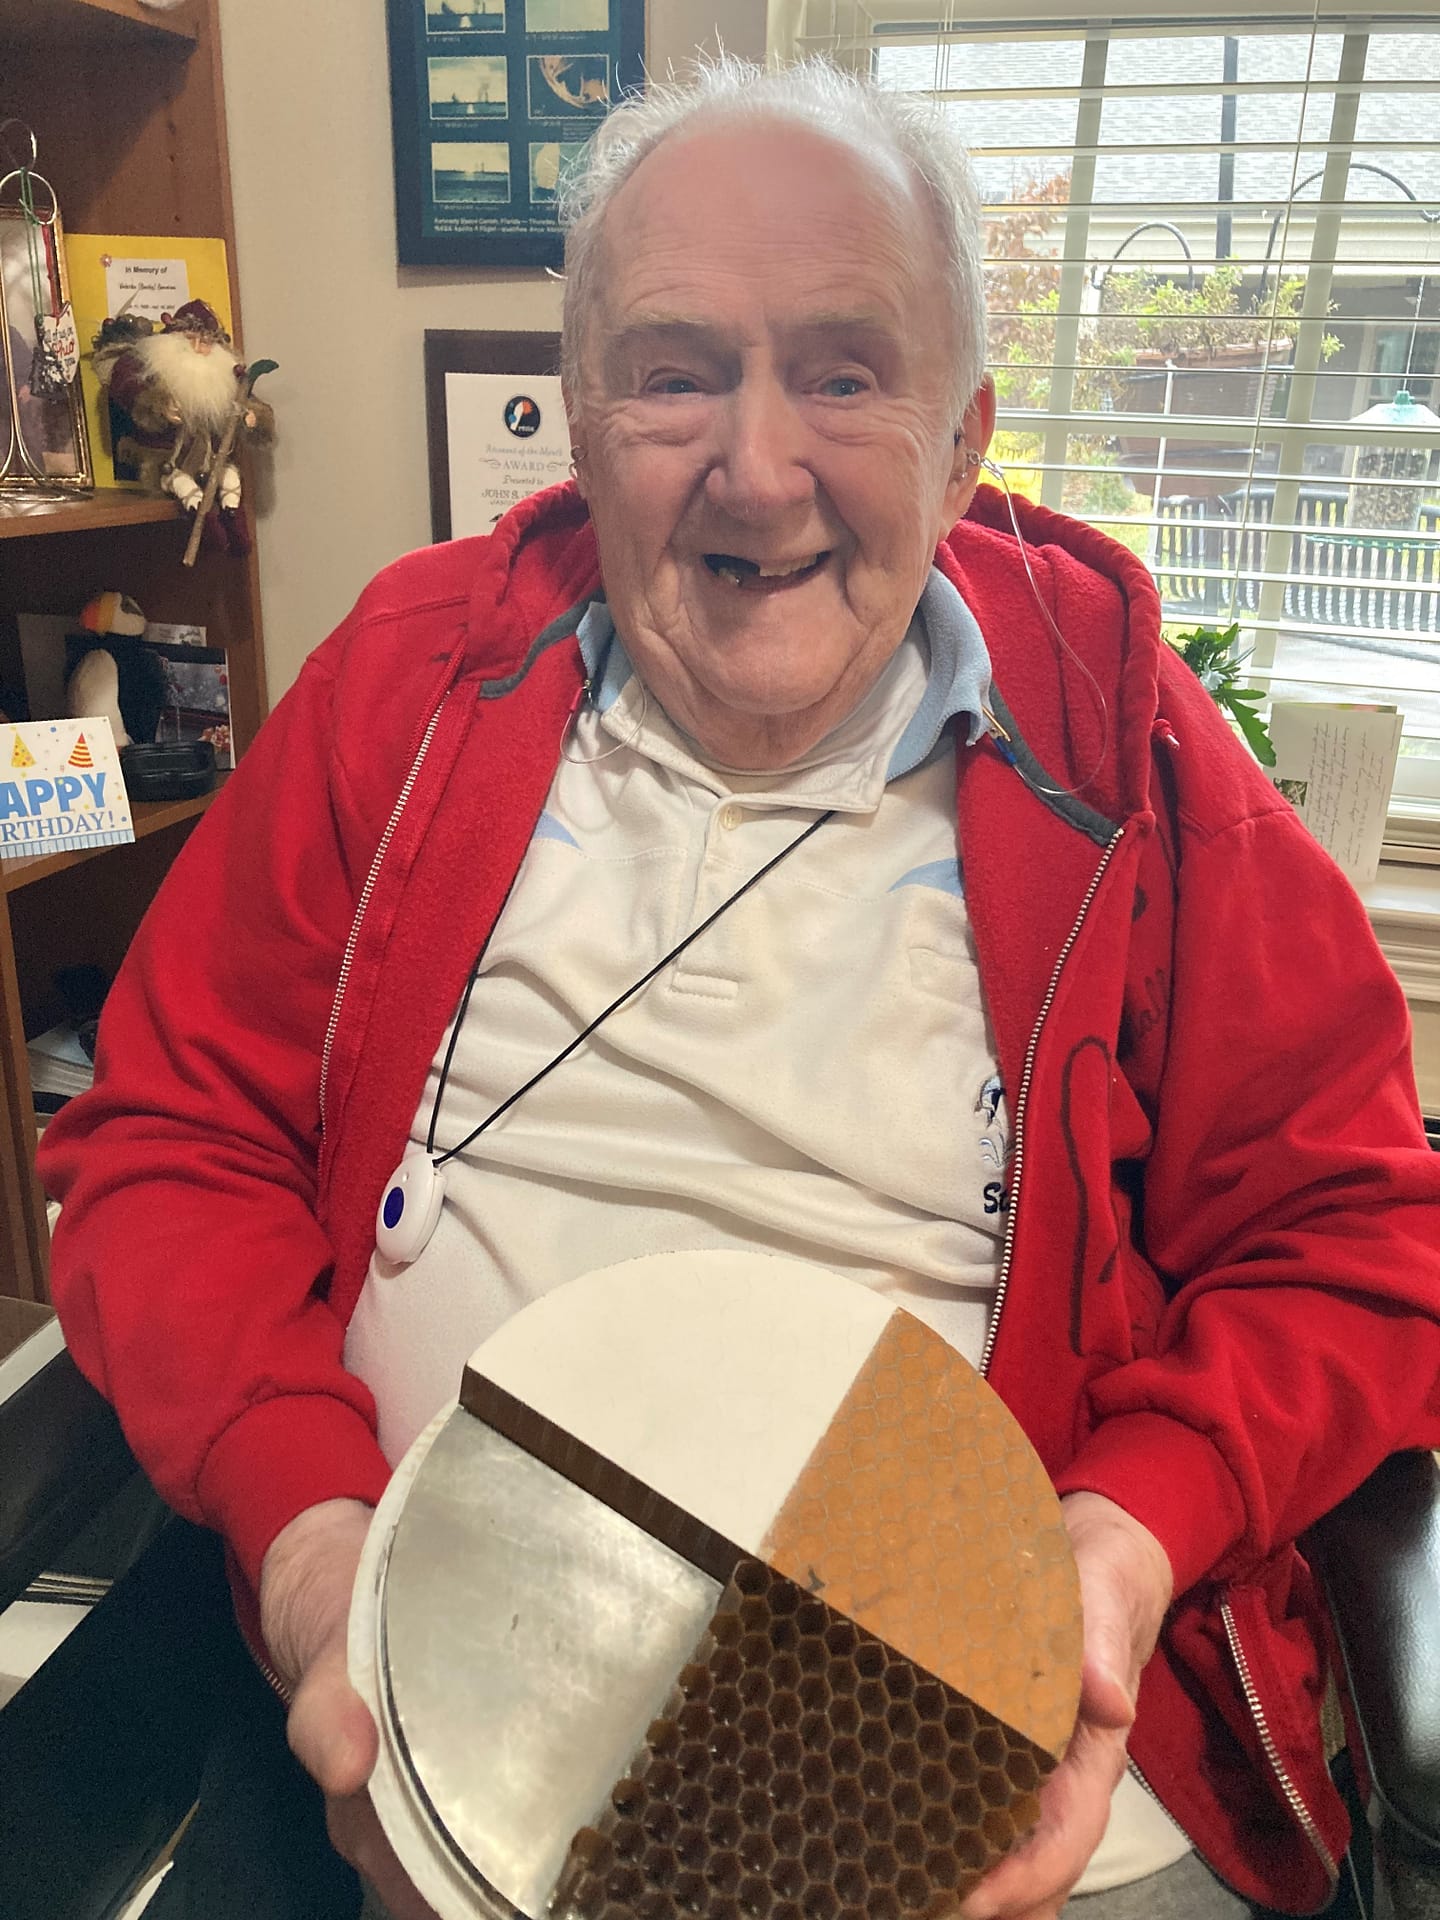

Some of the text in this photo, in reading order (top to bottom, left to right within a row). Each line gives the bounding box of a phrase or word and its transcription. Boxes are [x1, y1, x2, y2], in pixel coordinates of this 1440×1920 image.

[133, 266, 159, 275] Memory
[503, 461, 545, 472] AWARD
[502, 474, 536, 486] Presented
[481, 488, 510, 499] JOHN
